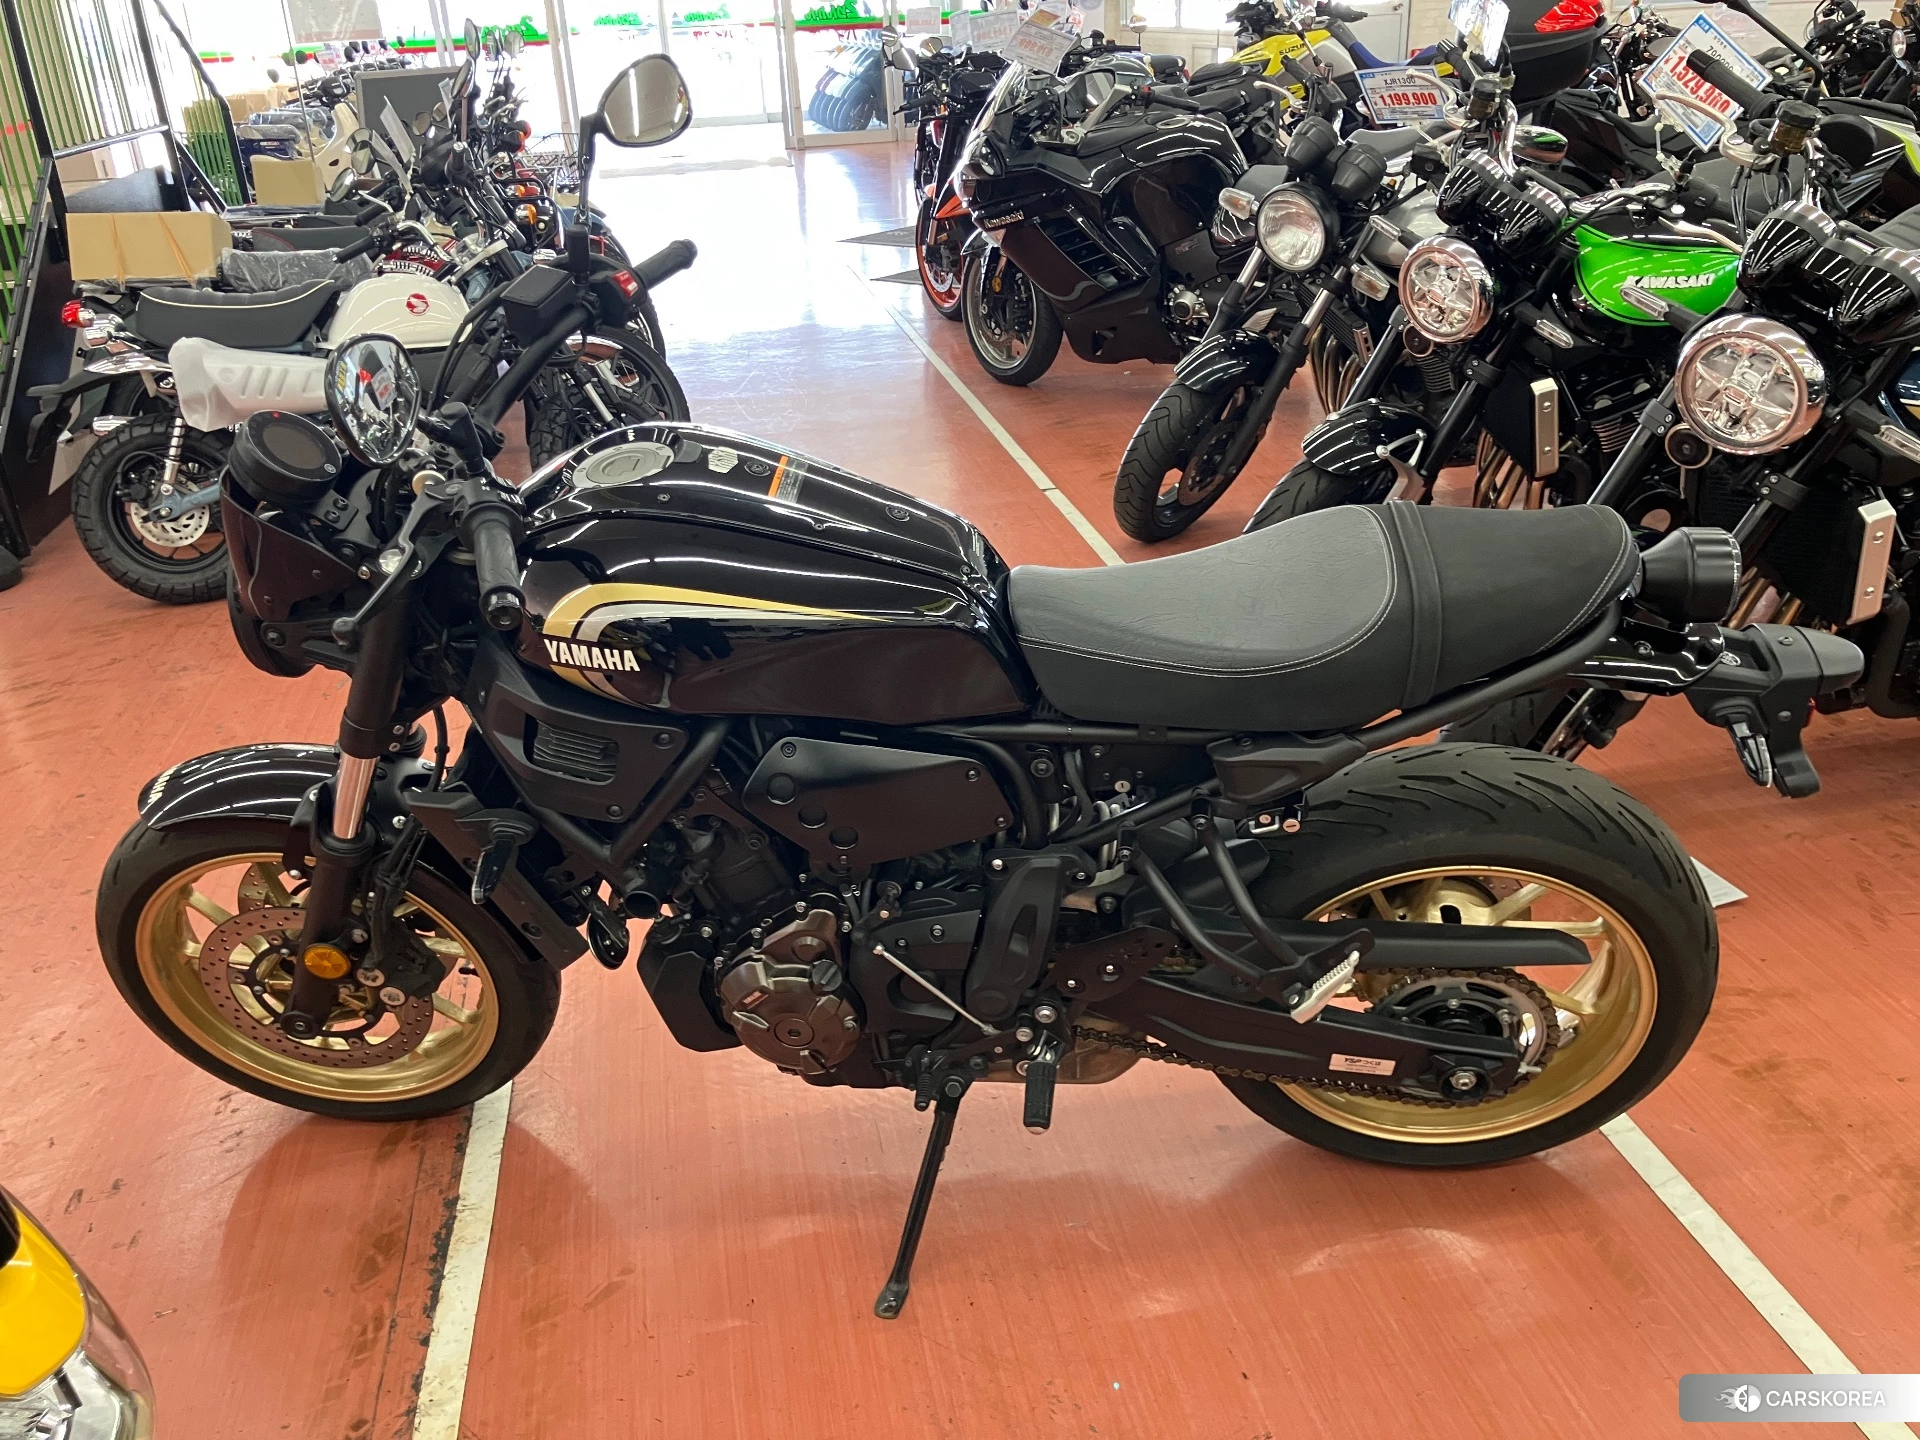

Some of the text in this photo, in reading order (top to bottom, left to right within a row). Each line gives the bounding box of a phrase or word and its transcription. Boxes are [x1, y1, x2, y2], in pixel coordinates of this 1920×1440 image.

[1383, 77, 1416, 86] XJR1300
[1379, 92, 1438, 108] 1,199,900
[984, 209, 1025, 228] Kawasaki
[1622, 273, 1716, 289] KAWASAKI
[543, 638, 641, 672] YAMAHA
